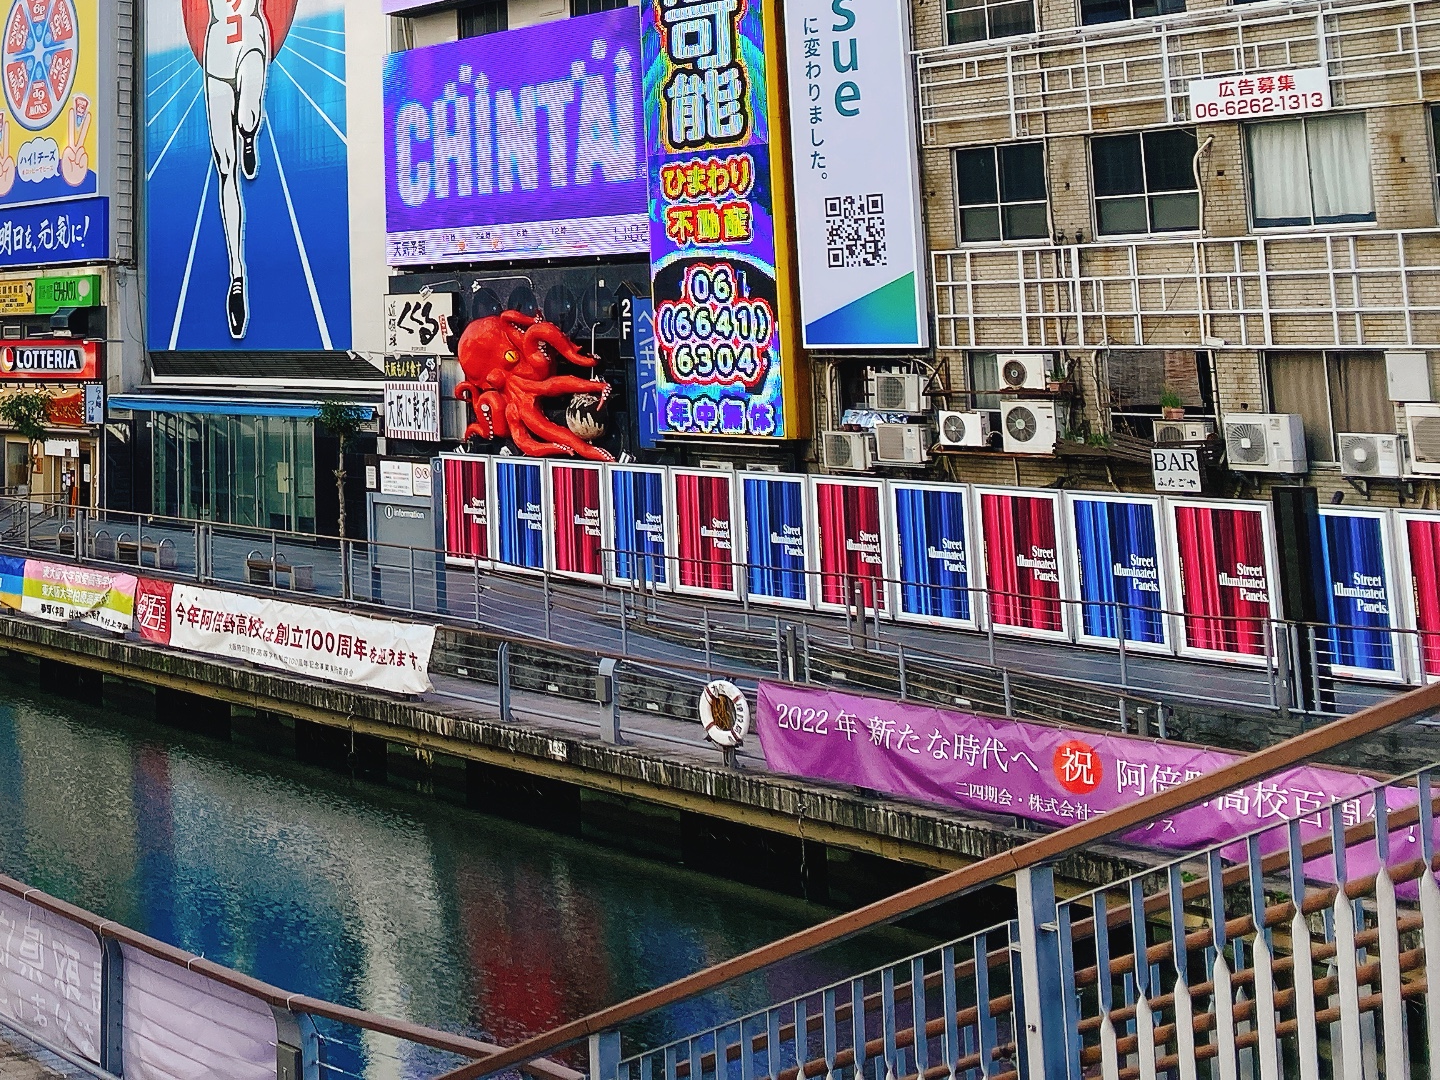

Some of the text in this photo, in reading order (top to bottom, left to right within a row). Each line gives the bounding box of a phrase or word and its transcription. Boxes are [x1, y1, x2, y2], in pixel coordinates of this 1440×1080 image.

[803, 17, 828, 180] に変わりました。
[1218, 74, 1297, 98] 広告募集
[1195, 93, 1323, 119] 06-6262-1313
[661, 158, 755, 200] ひまわり
[666, 201, 753, 248] 不動産
[688, 267, 734, 305] 06
[397, 301, 439, 345] くくる
[621, 298, 631, 340] 2F
[660, 305, 770, 344] (6641)
[16, 348, 78, 370] LOTTERIA
[675, 343, 759, 380] 6304
[667, 393, 775, 435] 年中無休
[1153, 450, 1198, 472] BAR
[1157, 477, 1197, 490] ふたごや
[942, 538, 962, 550] Street
[1031, 545, 1054, 559] Street
[1130, 553, 1154, 567] Street
[1236, 562, 1263, 577] Street
[1352, 571, 1382, 587] Street
[776, 703, 829, 737] 2022
[867, 713, 1039, 773] 新たな時代へ
[1060, 746, 1094, 787] 祝
